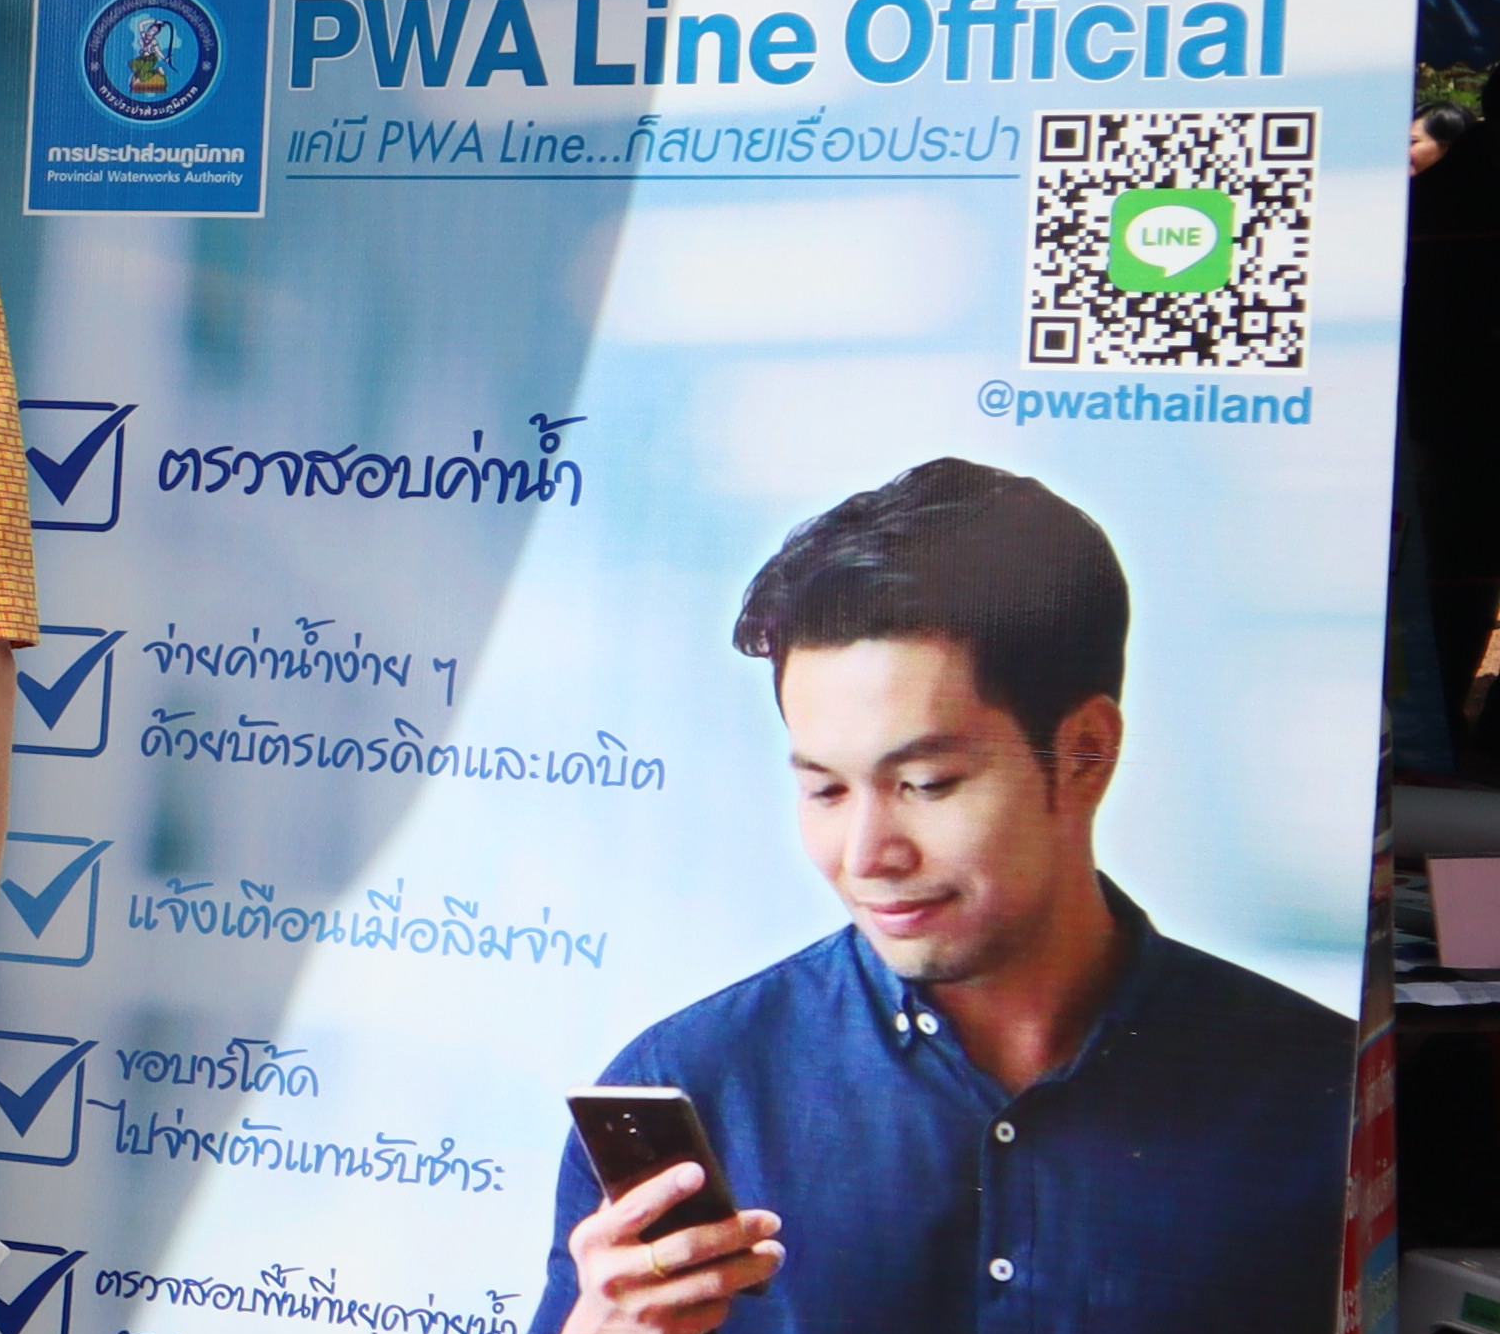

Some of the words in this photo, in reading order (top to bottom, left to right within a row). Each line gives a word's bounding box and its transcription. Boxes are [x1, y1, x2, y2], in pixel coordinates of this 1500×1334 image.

[47, 143, 245, 169] การประปาส่วนภูมิภาค
[376, 119, 485, 165] PWA
[46, 169, 104, 184] Provincial
[107, 170, 181, 185] Waterworks
[183, 171, 244, 187] Authority
[1141, 226, 1202, 247] LINE
[976, 378, 1313, 427] @pwathailand
[157, 412, 590, 507] ตรวจสอบค่าน้ำ
[142, 616, 413, 687] จ่ายค่าน้ำง่าย
[140, 707, 667, 792] ด้วยบัตรเครดิตและเดบิต
[127, 877, 609, 970] แจ้งเตือนเมื่อลืมจ่าย
[115, 1037, 321, 1098] ขอบาร์โค้ด
[86, 1097, 507, 1194] ไปจ่ายตัวแทนรับชำระ
